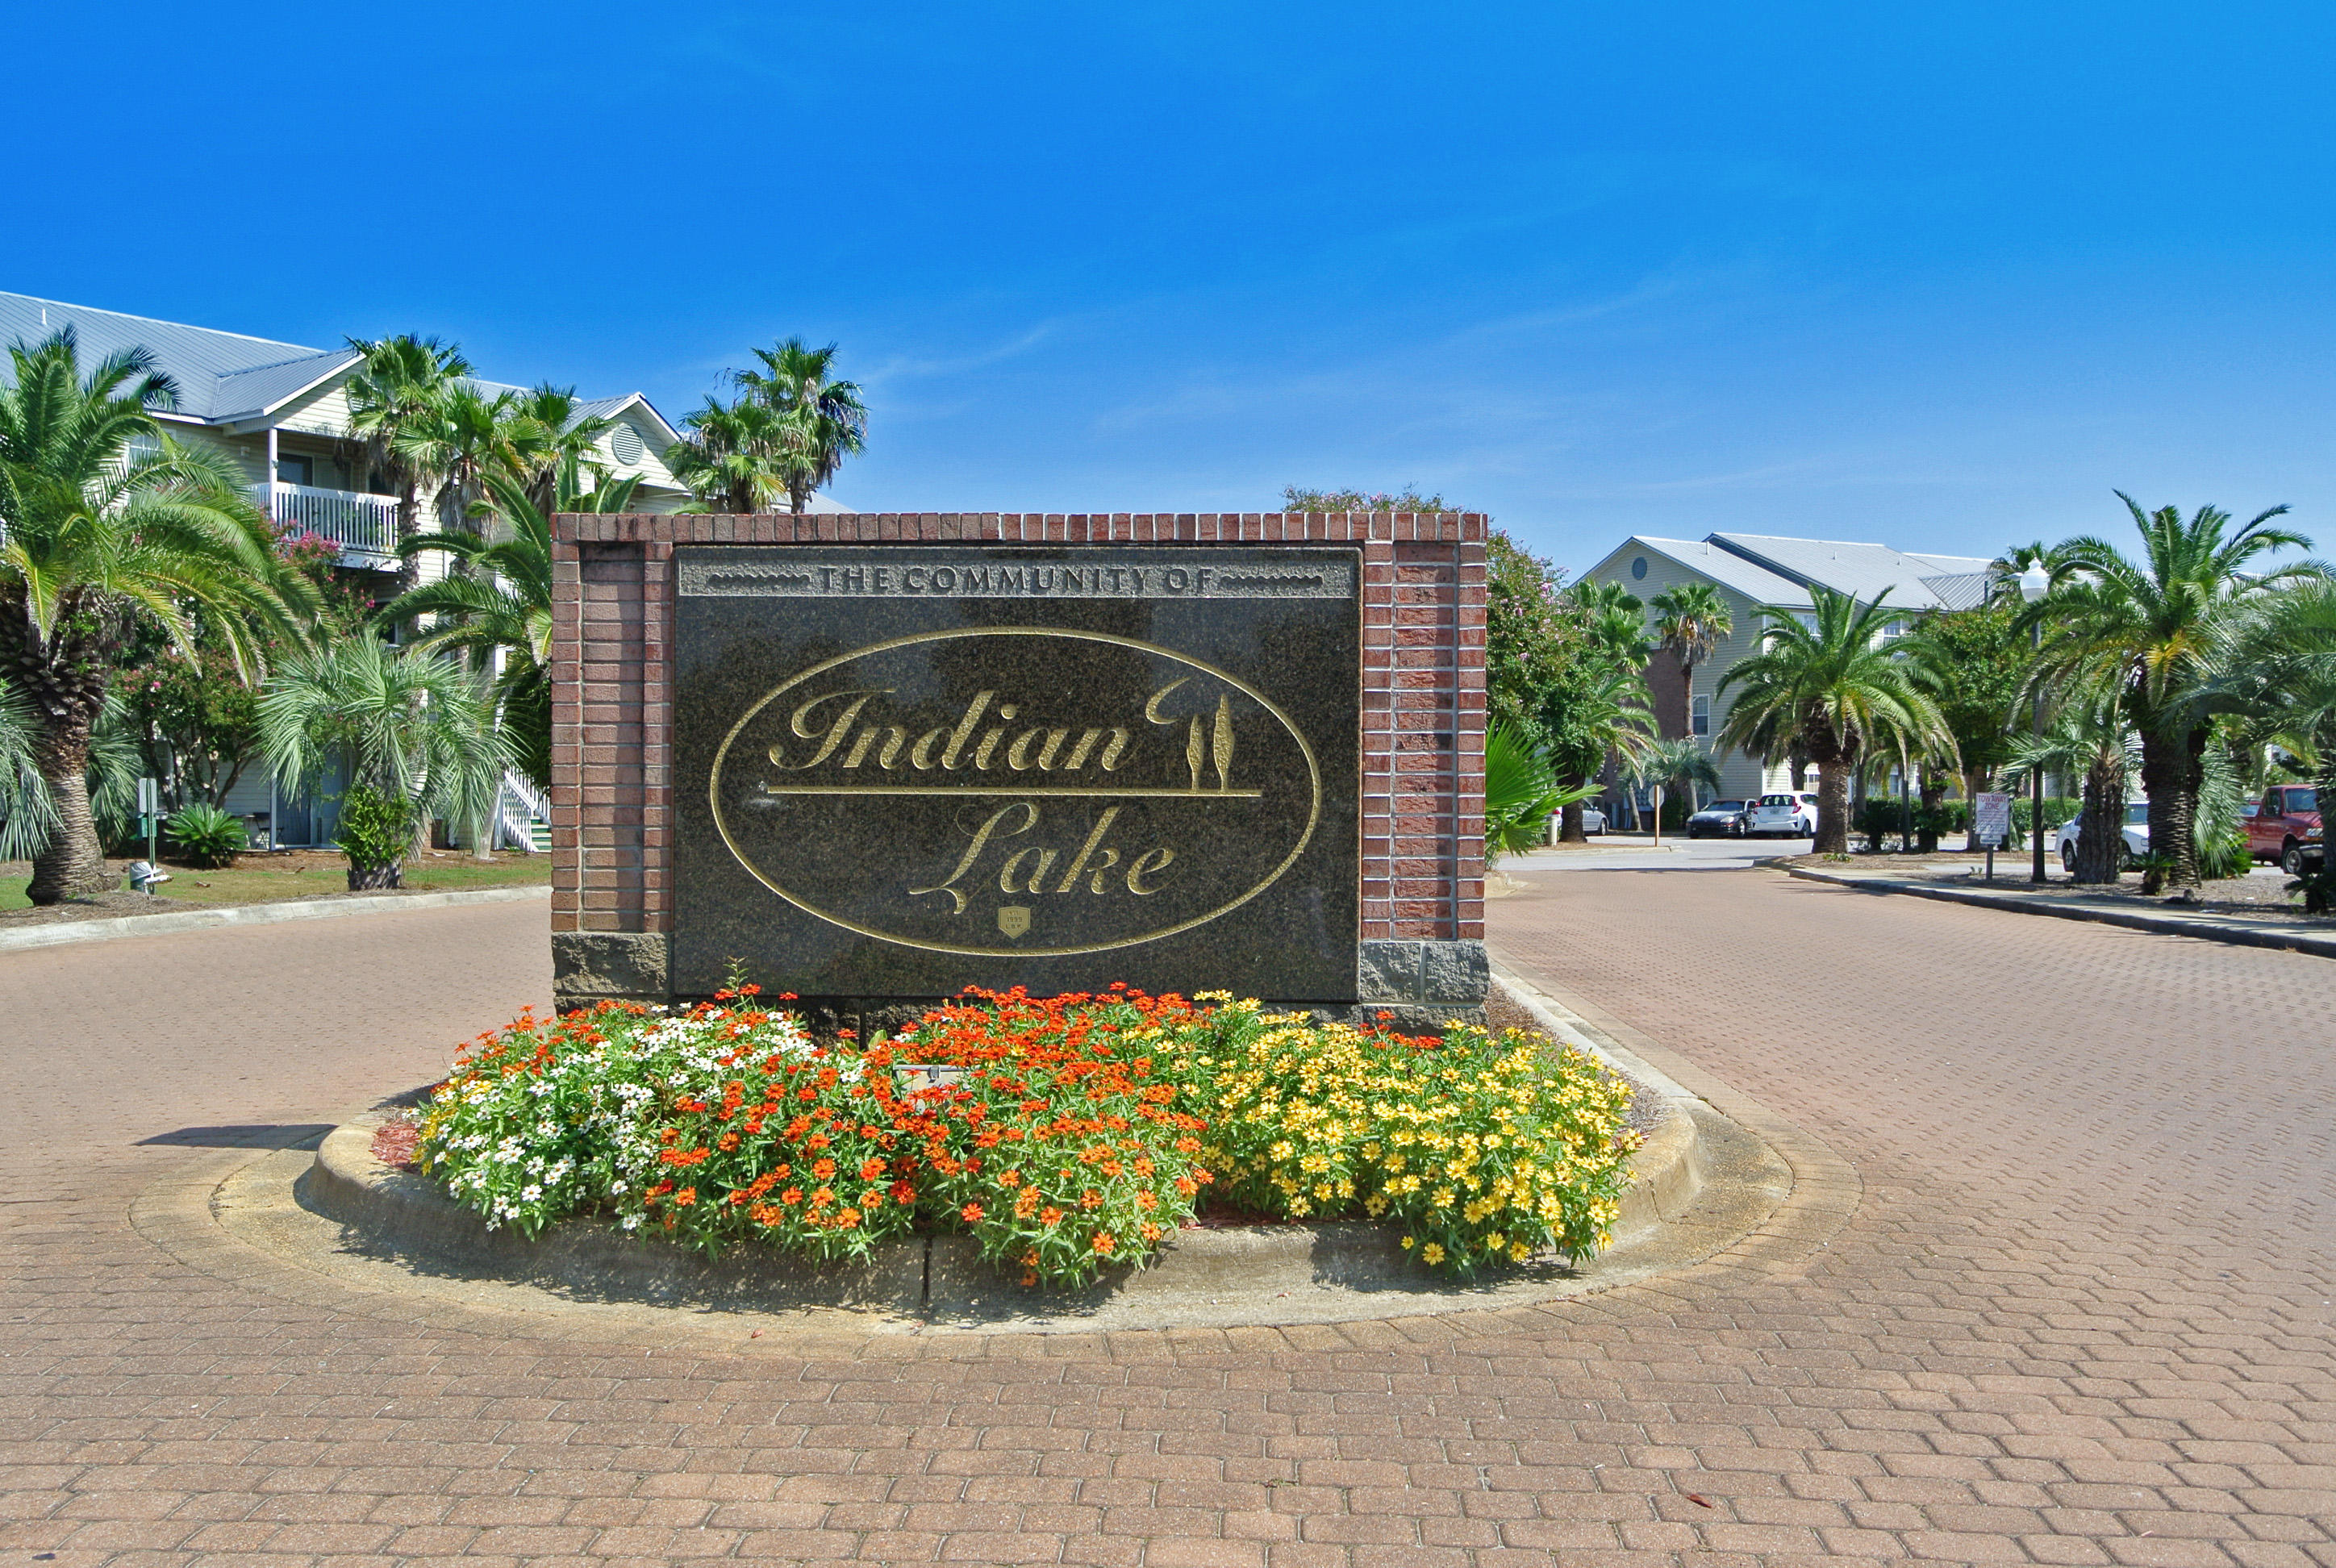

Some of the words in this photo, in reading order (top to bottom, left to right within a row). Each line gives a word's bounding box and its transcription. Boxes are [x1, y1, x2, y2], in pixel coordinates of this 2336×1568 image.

[819, 565, 888, 590] THE
[902, 565, 1152, 591] COMMUNITY
[1164, 566, 1213, 591] OF
[769, 689, 1139, 771] Indian
[909, 803, 1181, 914] Lake
